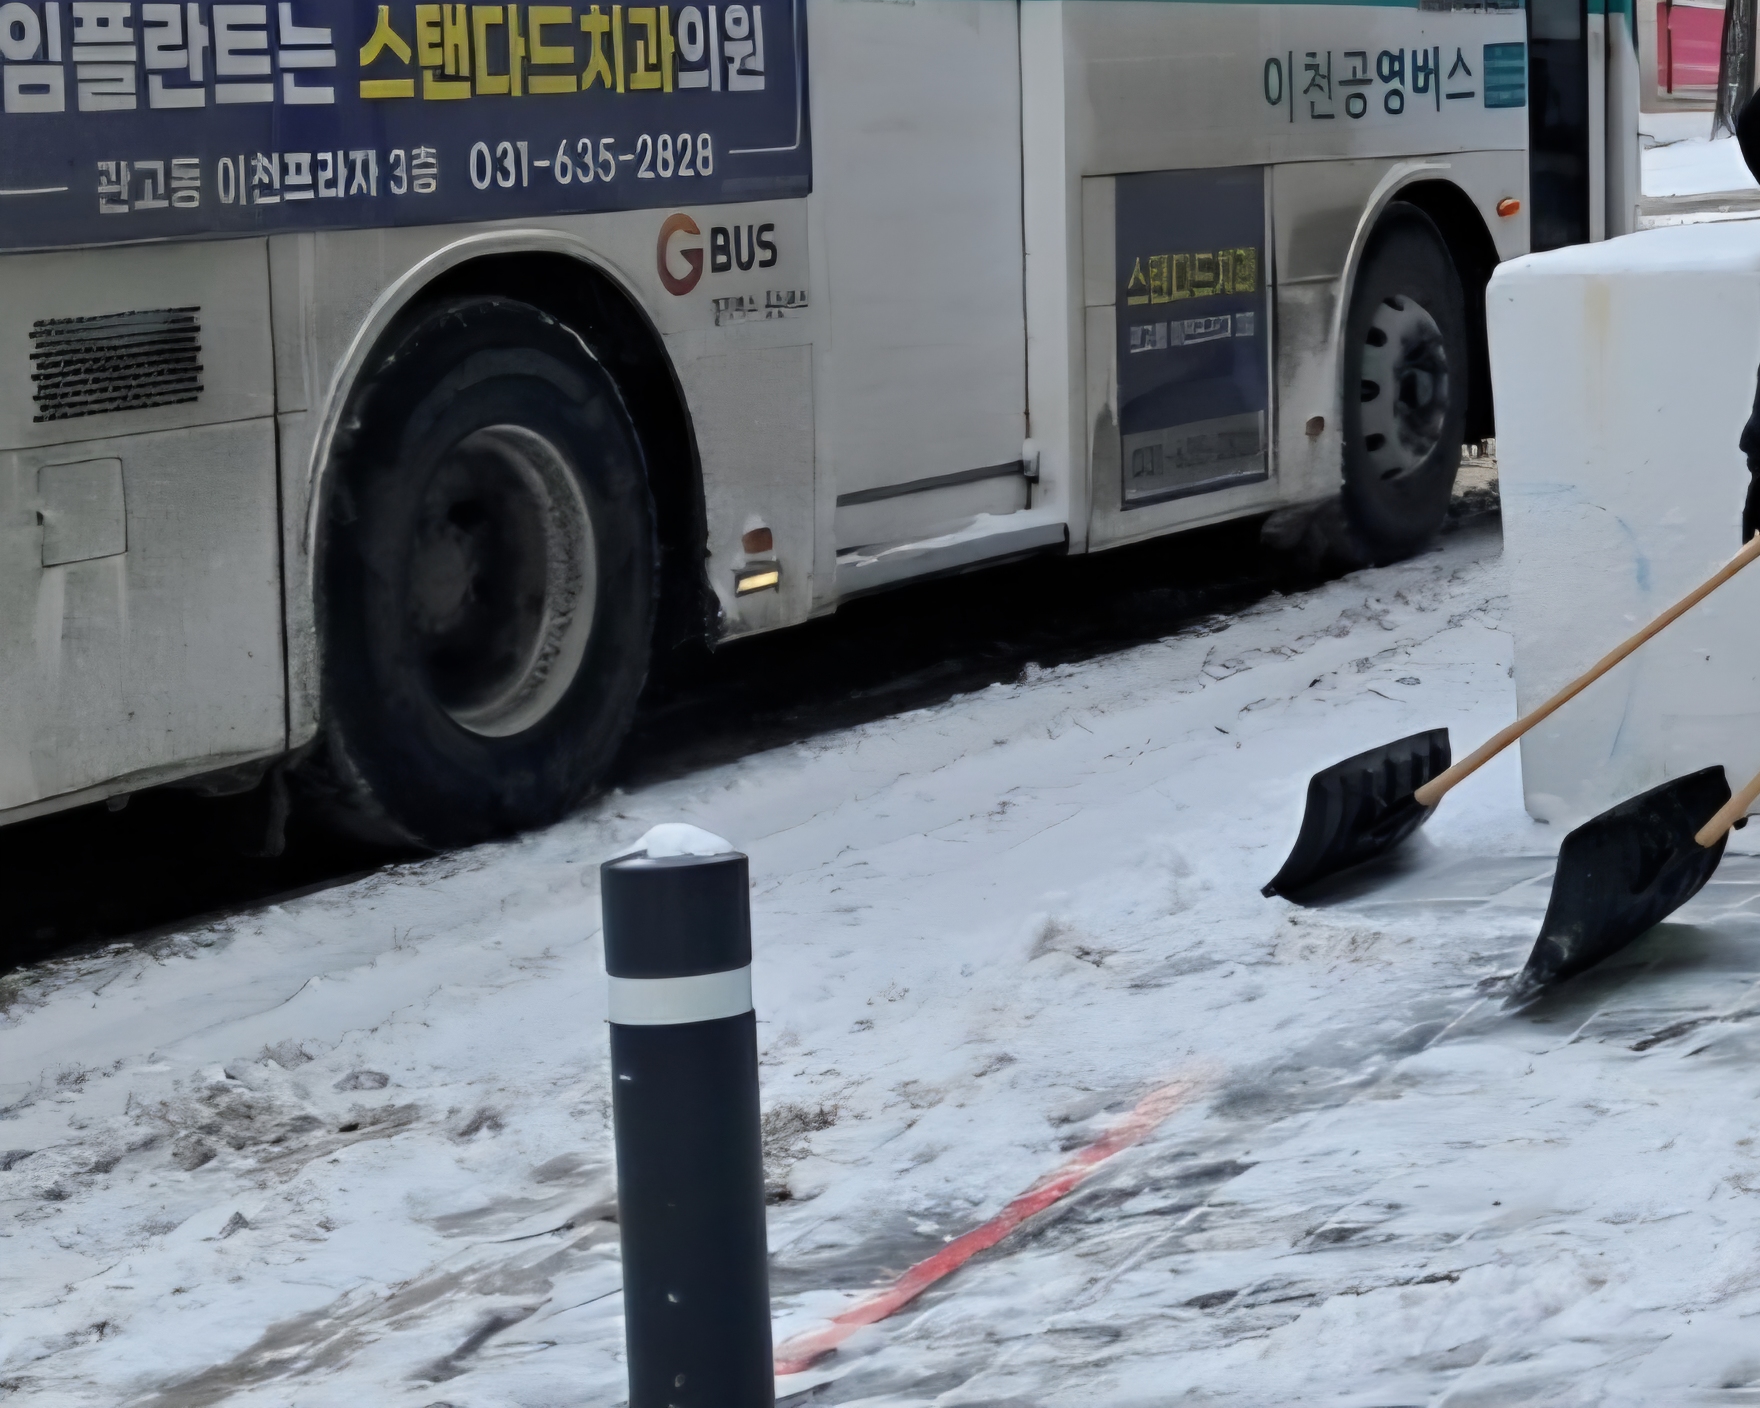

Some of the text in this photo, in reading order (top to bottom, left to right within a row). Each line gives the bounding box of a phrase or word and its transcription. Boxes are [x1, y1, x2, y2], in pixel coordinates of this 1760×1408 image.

[0, 1, 337, 113] 임플란트는
[1264, 45, 1476, 123] 이천공영버스
[216, 149, 379, 206] 이천프라자
[469, 133, 714, 191] 031-635-2828
